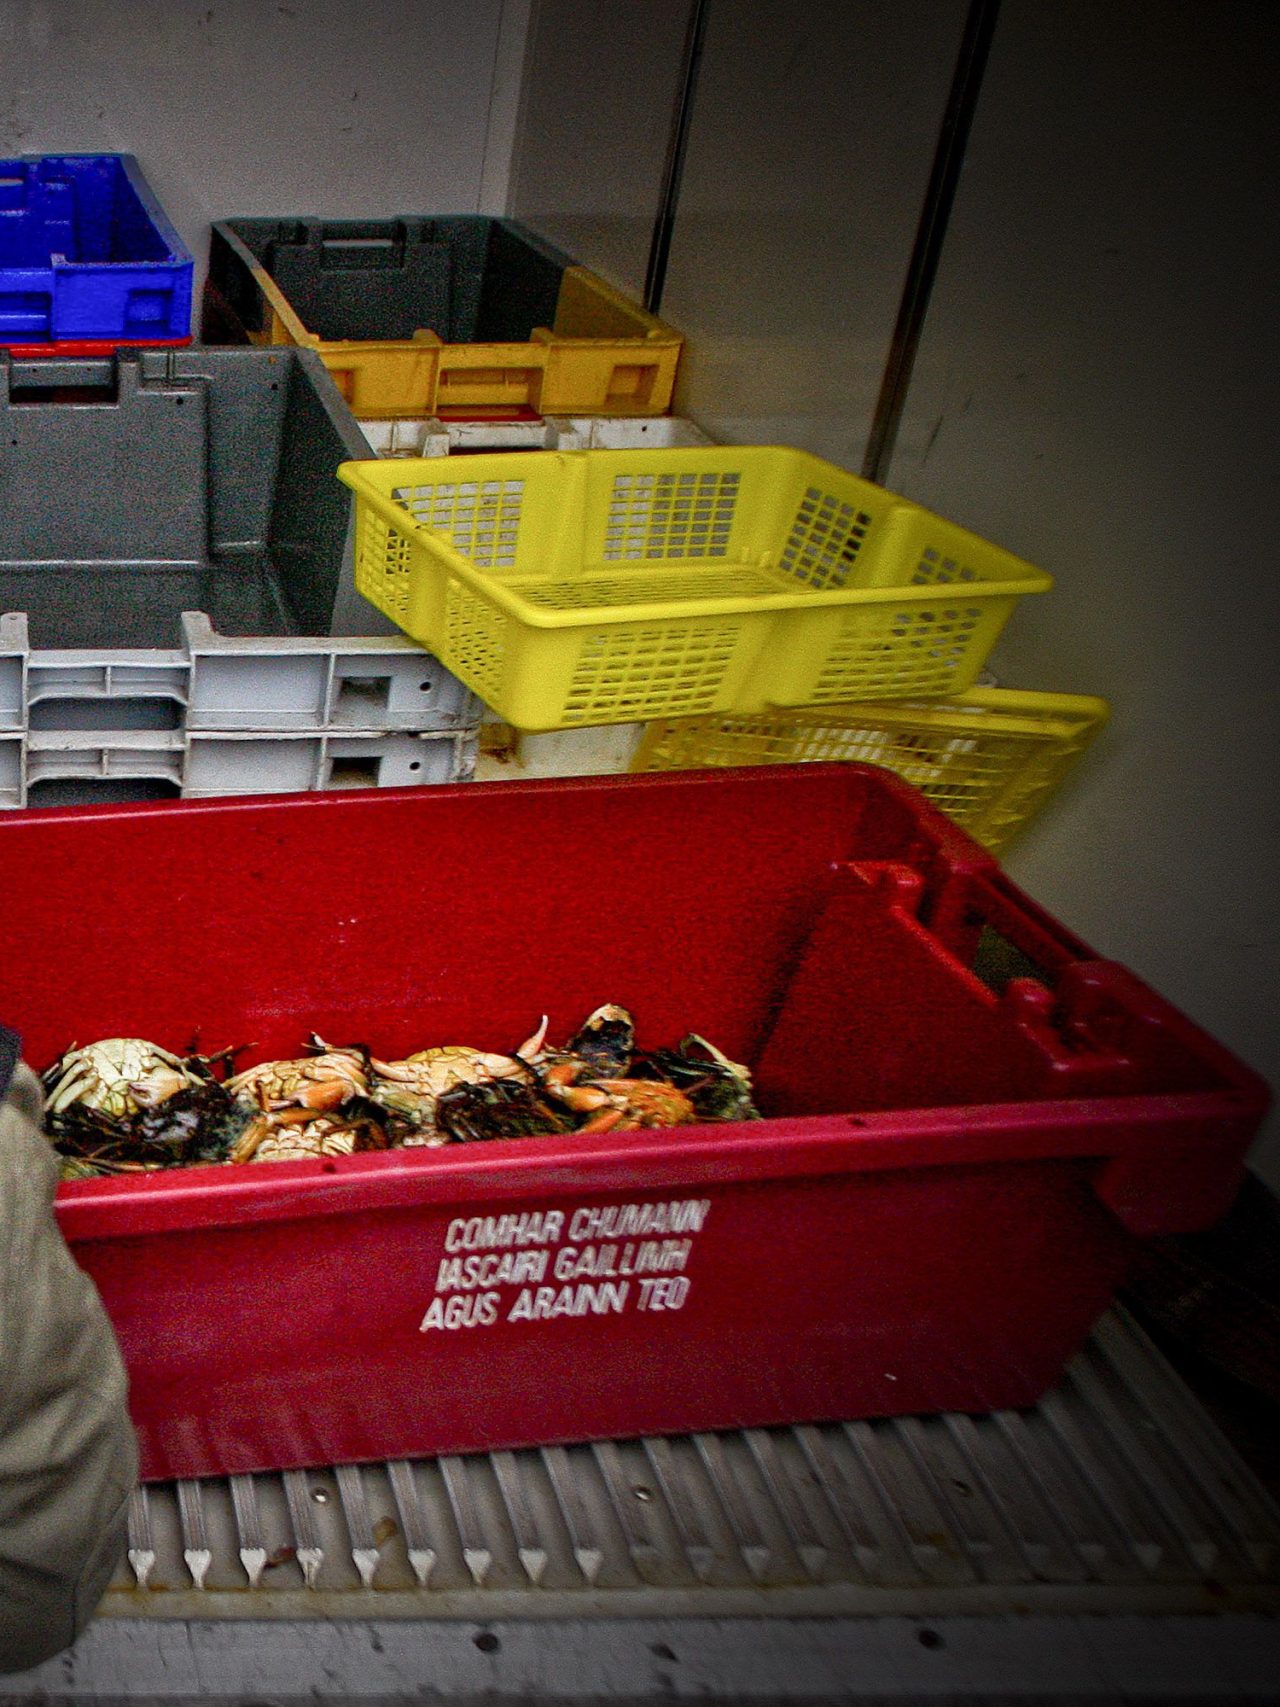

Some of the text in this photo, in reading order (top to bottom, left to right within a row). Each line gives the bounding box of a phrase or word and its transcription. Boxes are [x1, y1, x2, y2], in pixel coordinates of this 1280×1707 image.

[444, 1199, 712, 1253] COMHAR CHUMANN
[419, 1277, 692, 1333] AGUS ARAINN TEO
